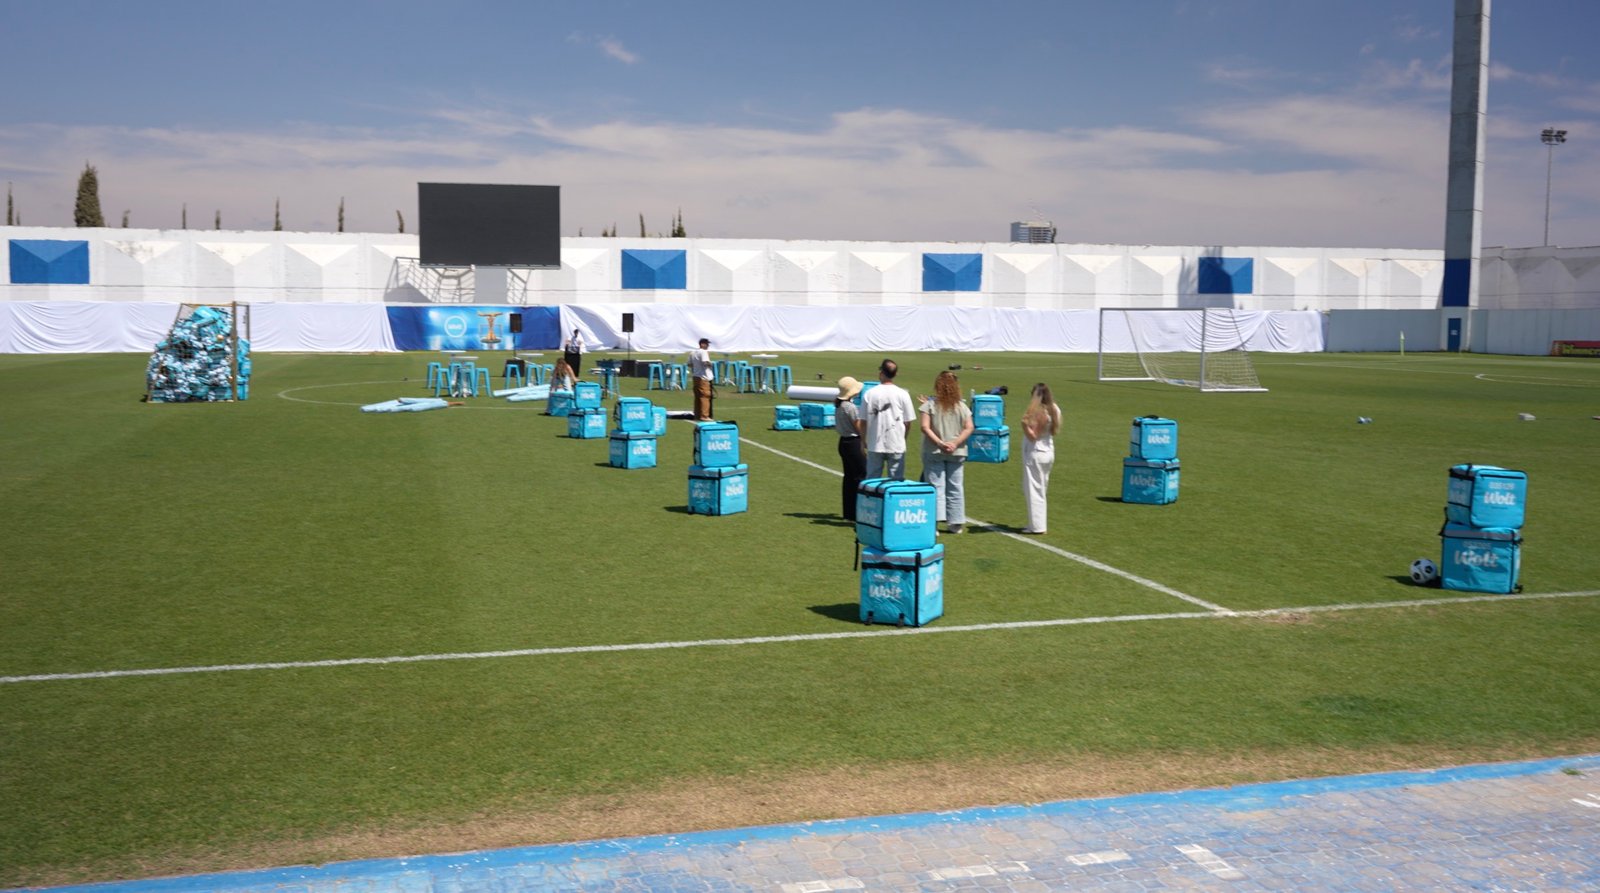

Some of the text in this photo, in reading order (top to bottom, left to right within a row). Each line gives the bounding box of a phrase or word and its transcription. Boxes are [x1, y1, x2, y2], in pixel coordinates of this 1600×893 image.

[707, 440, 732, 450] Wolt
[1484, 492, 1516, 506] Wolt
[894, 509, 928, 524] Wolt
[1455, 550, 1498, 567] Wolt
[868, 584, 902, 599] Wolt
